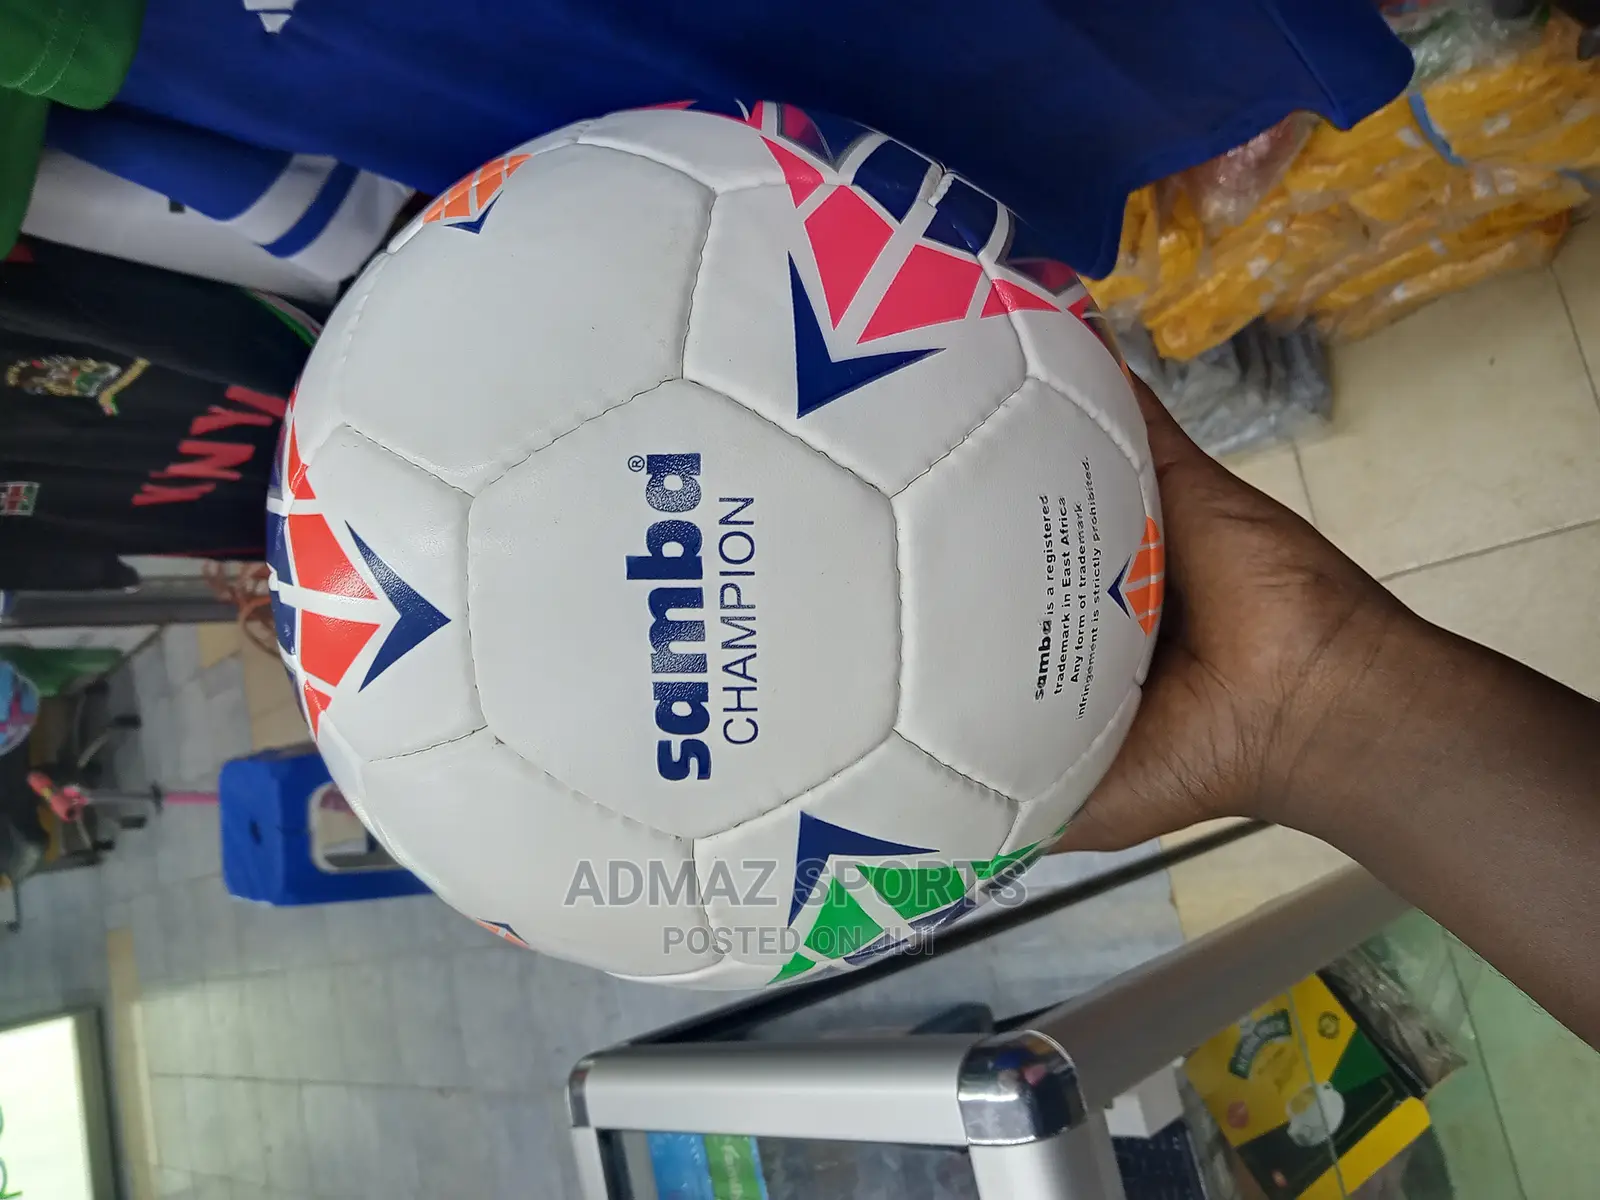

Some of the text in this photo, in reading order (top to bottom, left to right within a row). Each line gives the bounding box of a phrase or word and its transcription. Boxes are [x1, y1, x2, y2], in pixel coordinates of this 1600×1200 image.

[718, 497, 758, 745] CHAMPION
[1039, 495, 1056, 581] registered
[1045, 602, 1054, 615] is
[1047, 587, 1054, 595] a
[1054, 497, 1071, 695] trademark in East Africa
[1070, 503, 1087, 683] Any form of trademark
[1076, 455, 1102, 721] infringement is strictly prohibited.
